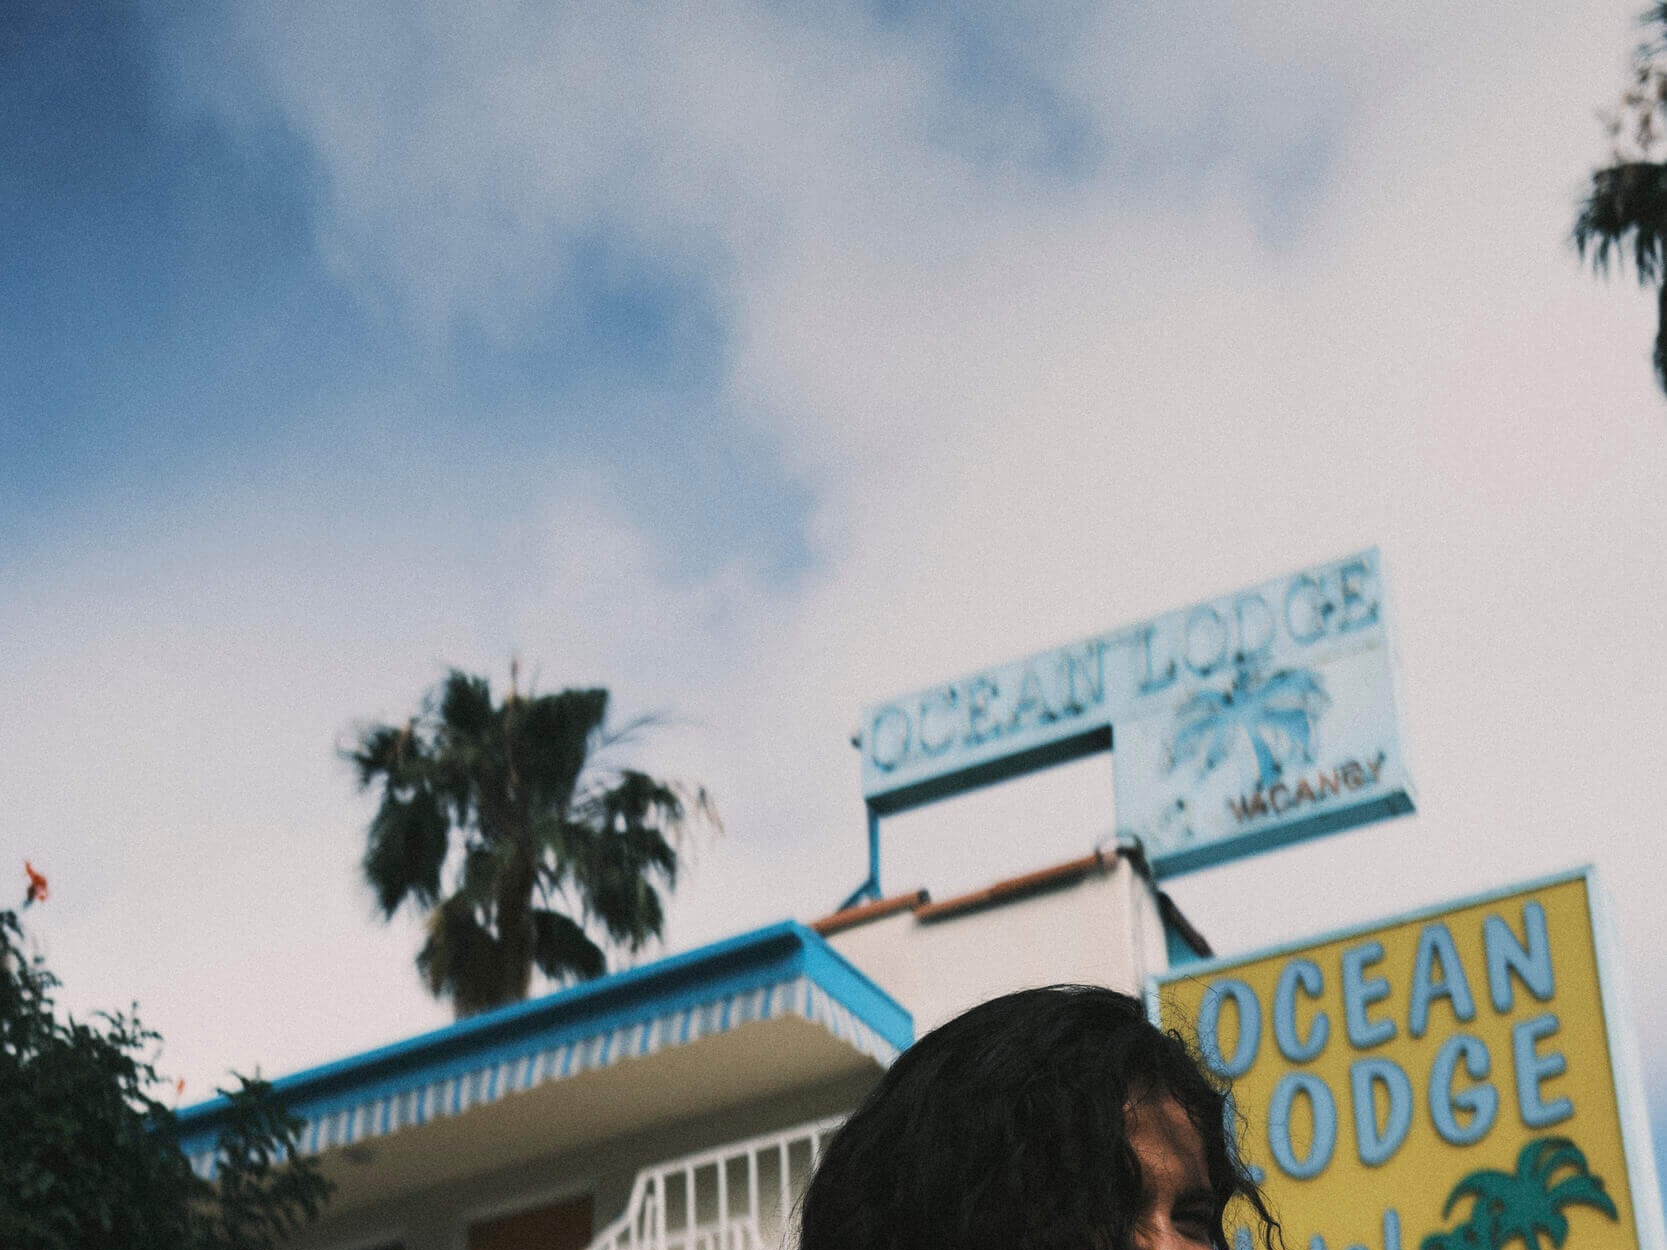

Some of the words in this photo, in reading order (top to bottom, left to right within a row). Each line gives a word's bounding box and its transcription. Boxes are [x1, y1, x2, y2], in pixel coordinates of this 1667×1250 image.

[870, 635, 1104, 774] OCEAN
[1137, 556, 1383, 696] LODGE
[1197, 900, 1555, 1079] OCEAN
